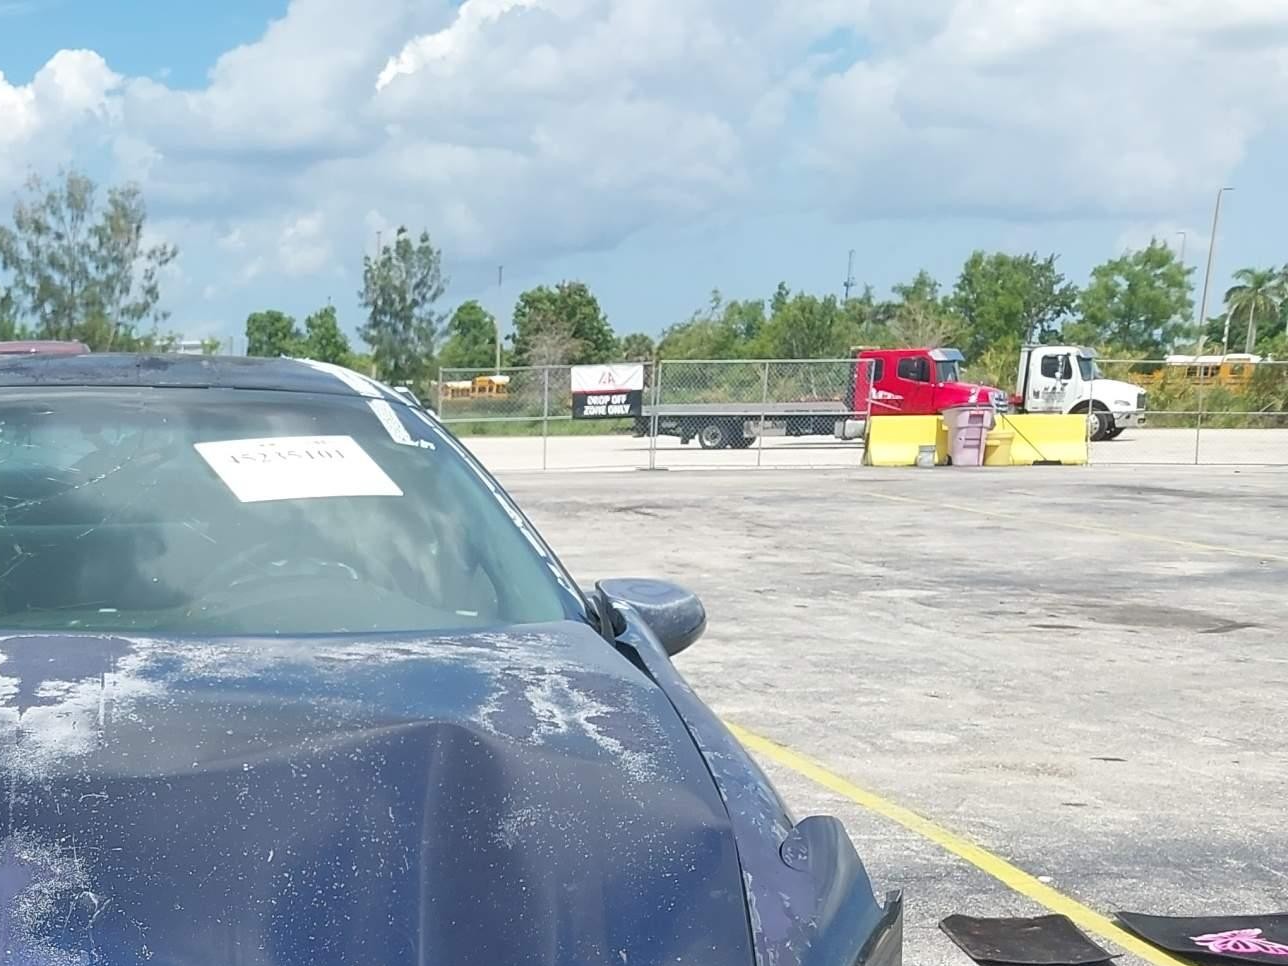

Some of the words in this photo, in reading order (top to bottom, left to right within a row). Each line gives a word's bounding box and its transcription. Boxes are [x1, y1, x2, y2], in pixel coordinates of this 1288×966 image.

[587, 395, 610, 405] DROP
[612, 394, 627, 405] OFF
[583, 405, 607, 416] ZONE
[608, 404, 631, 415] ONLY
